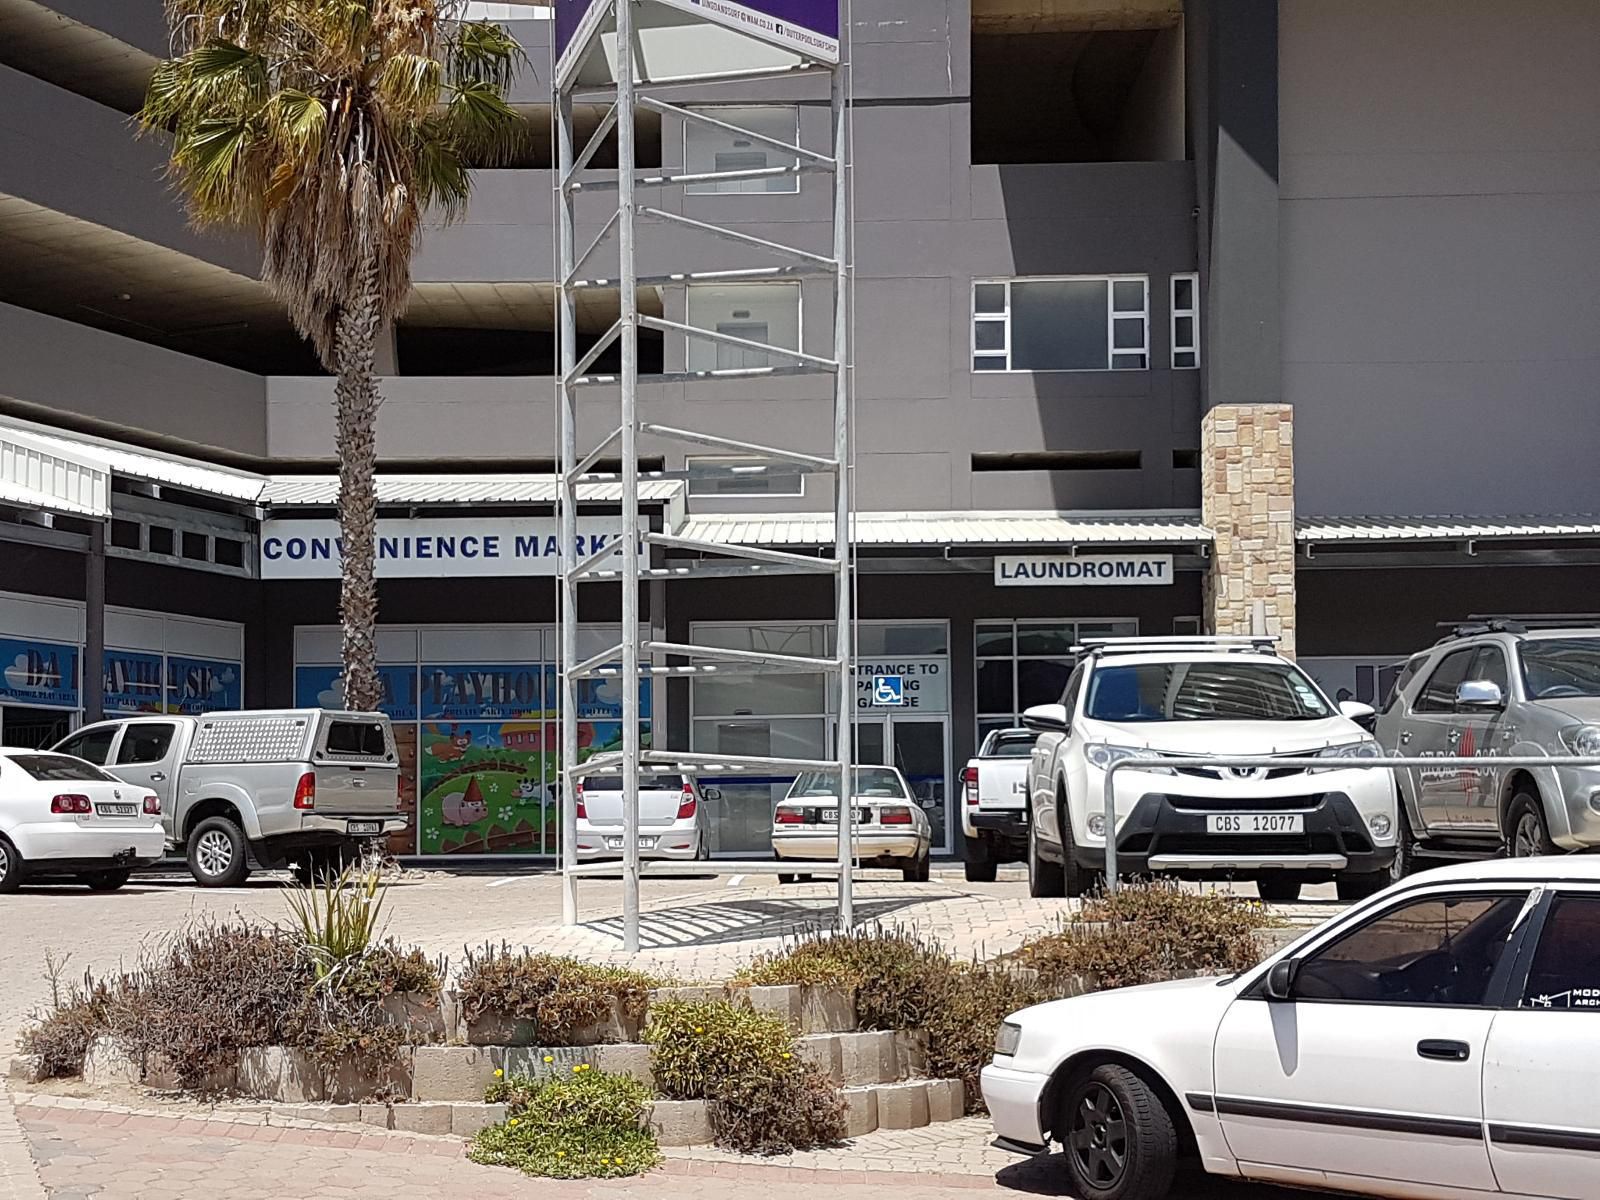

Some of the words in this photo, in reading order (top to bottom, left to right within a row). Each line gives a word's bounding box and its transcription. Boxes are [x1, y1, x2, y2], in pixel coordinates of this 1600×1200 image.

[263, 535, 500, 560] CONNIENCE
[1000, 560, 1167, 579] LAUNDROMAT
[919, 664, 939, 675] TO
[857, 681, 920, 691] PANG
[1216, 816, 1241, 831] CBS
[1253, 816, 1295, 831] 12077
